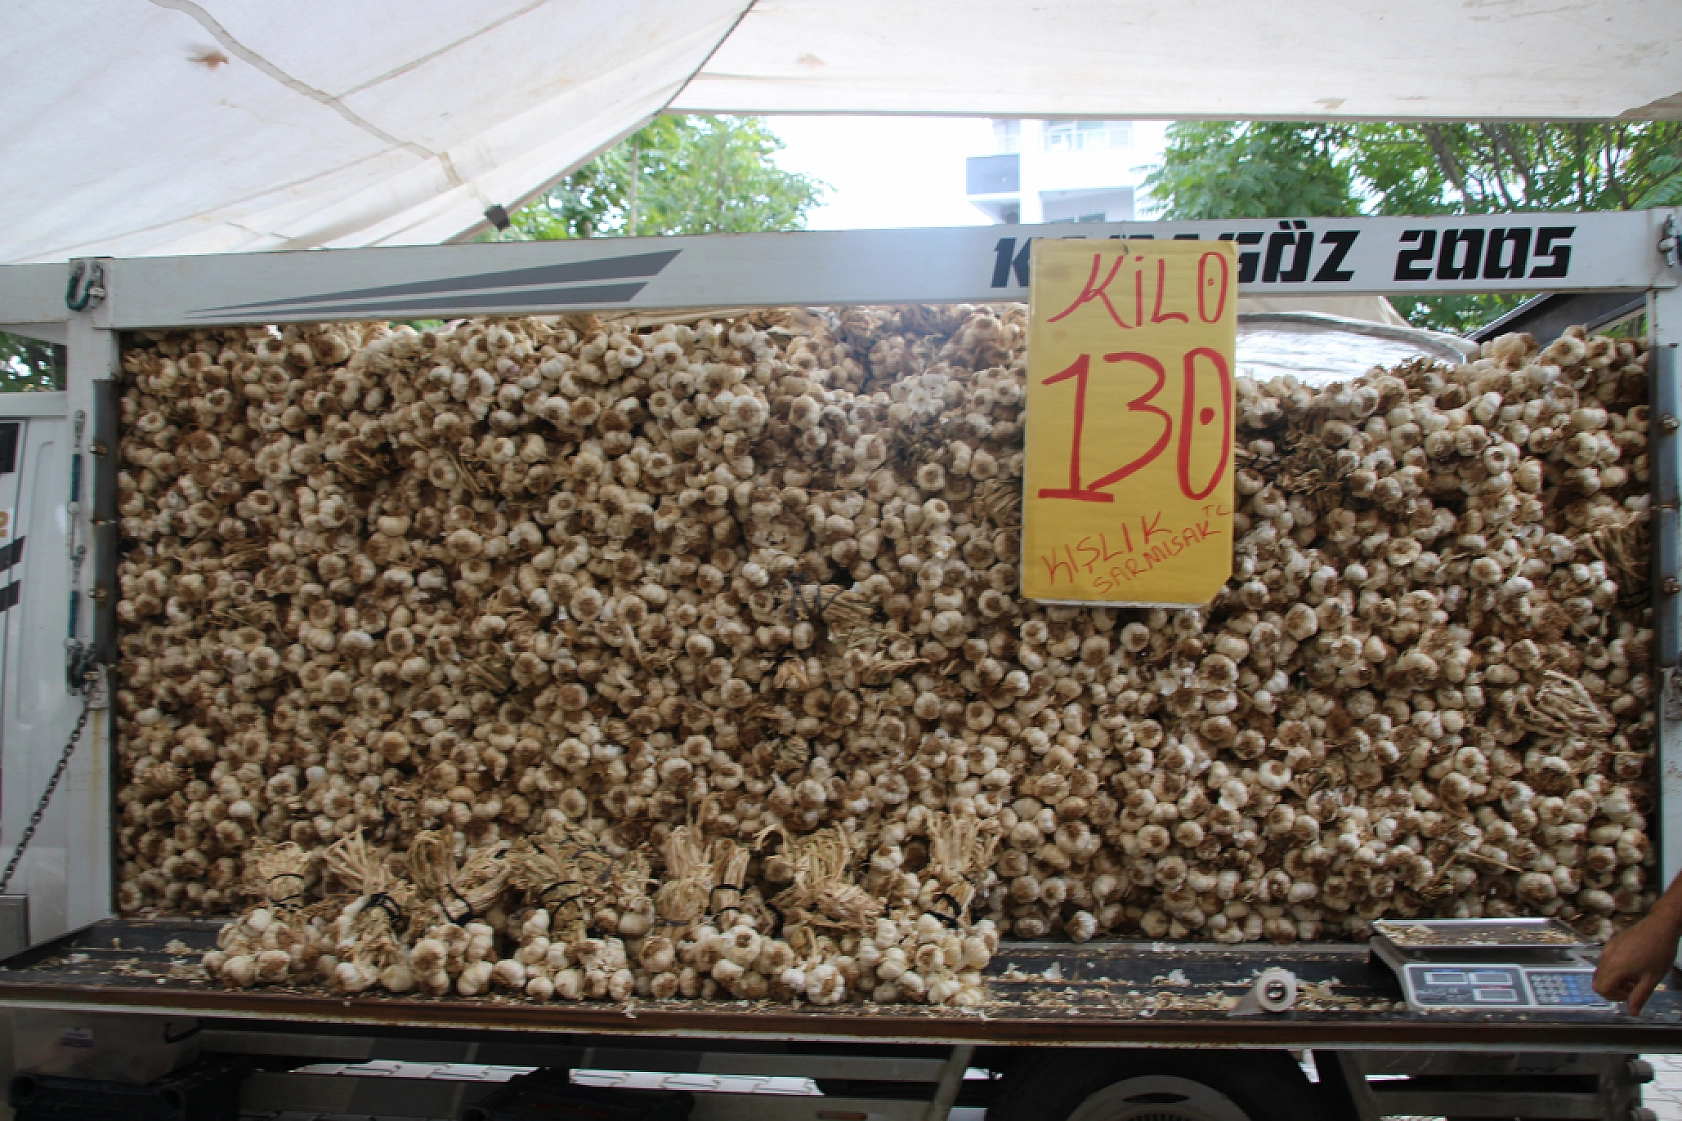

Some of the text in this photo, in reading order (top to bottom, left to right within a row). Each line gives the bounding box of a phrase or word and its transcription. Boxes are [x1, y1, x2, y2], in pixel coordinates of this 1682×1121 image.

[1393, 226, 1577, 281] 2005
[1037, 347, 1232, 503] 130
[1202, 504, 1232, 517] TL
